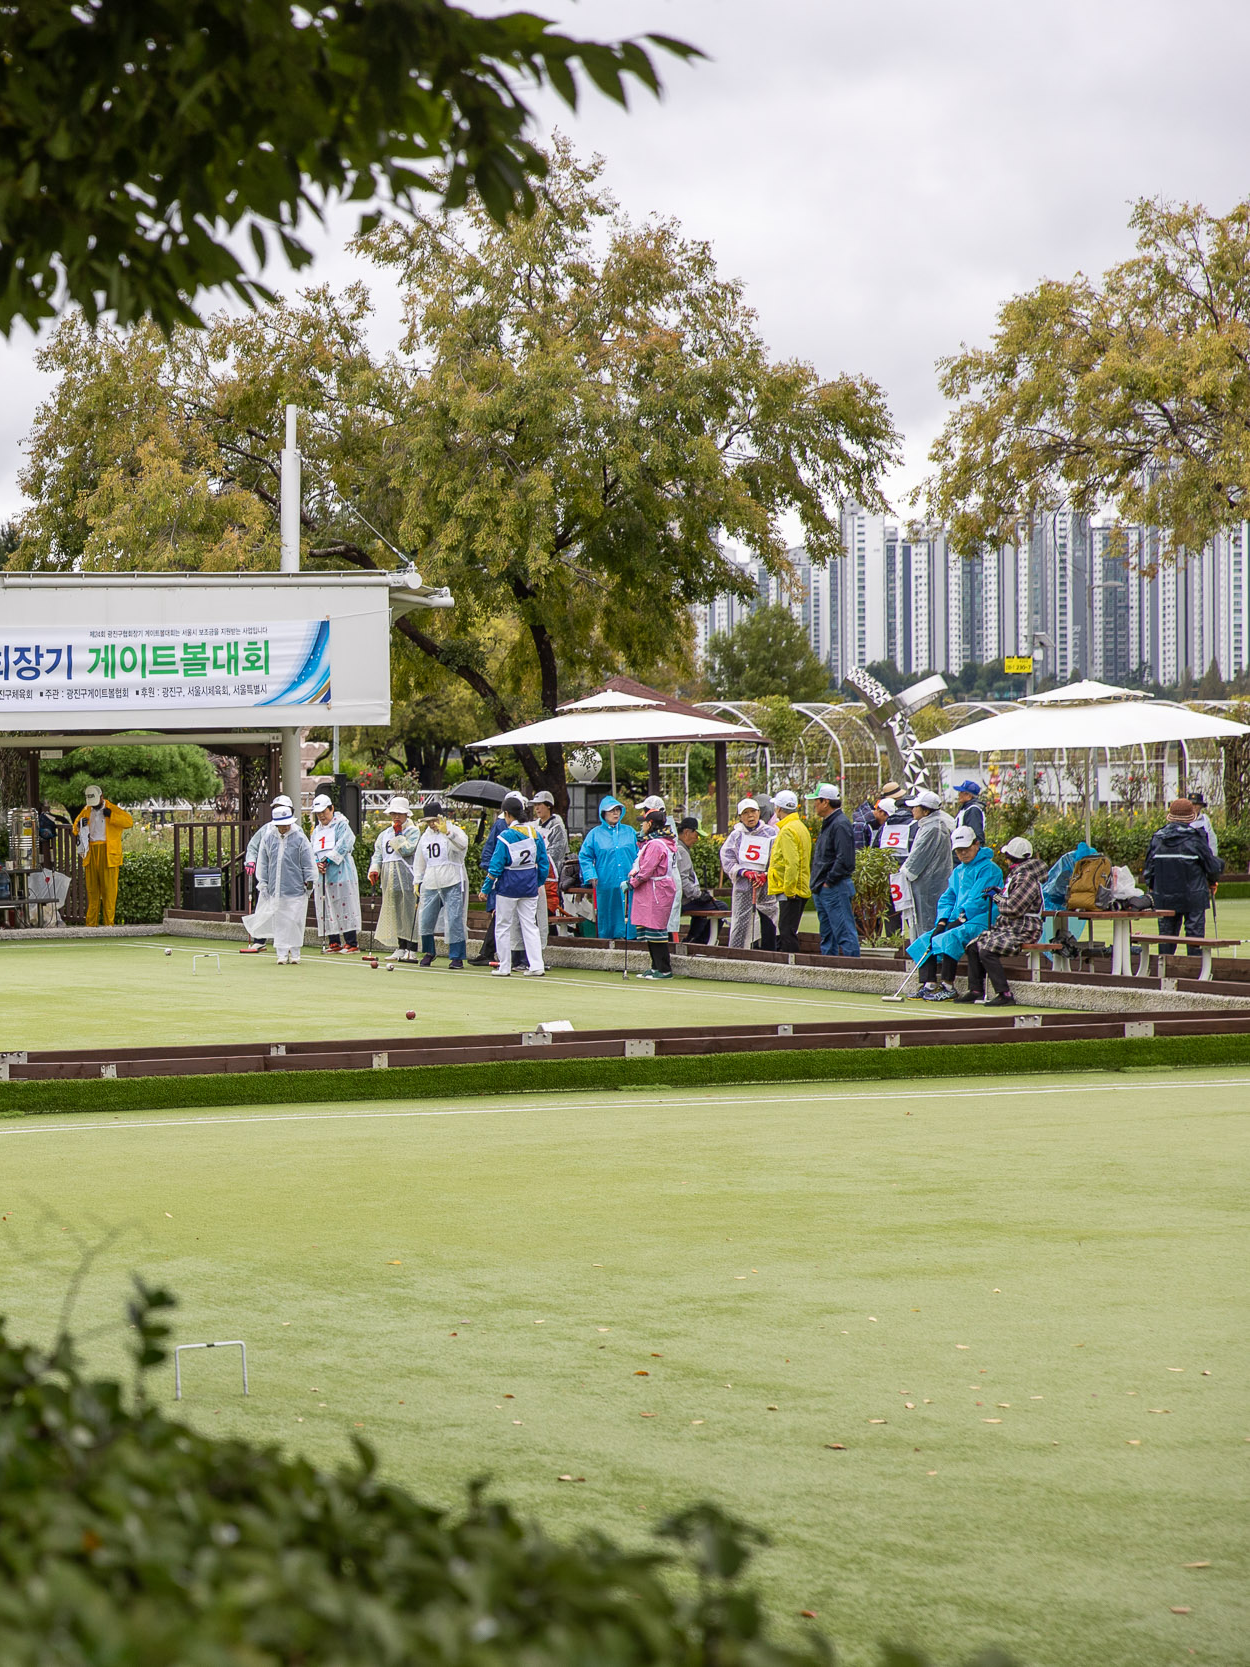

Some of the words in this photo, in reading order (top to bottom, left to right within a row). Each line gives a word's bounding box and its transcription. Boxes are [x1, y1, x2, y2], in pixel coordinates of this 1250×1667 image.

[86, 640, 270, 680] 게이트볼대회
[44, 688, 60, 700] 주관
[66, 687, 129, 699] 광진구게이트볼협회
[140, 686, 155, 699] 후원
[161, 687, 185, 698] 광진구,
[187, 685, 231, 697] 서울시체육회,
[233, 684, 268, 697] 서울특별시
[318, 836, 326, 849] 1
[886, 832, 901, 847] 5
[426, 842, 441, 859] 10
[519, 849, 531, 866] 2
[744, 844, 762, 861] 5
